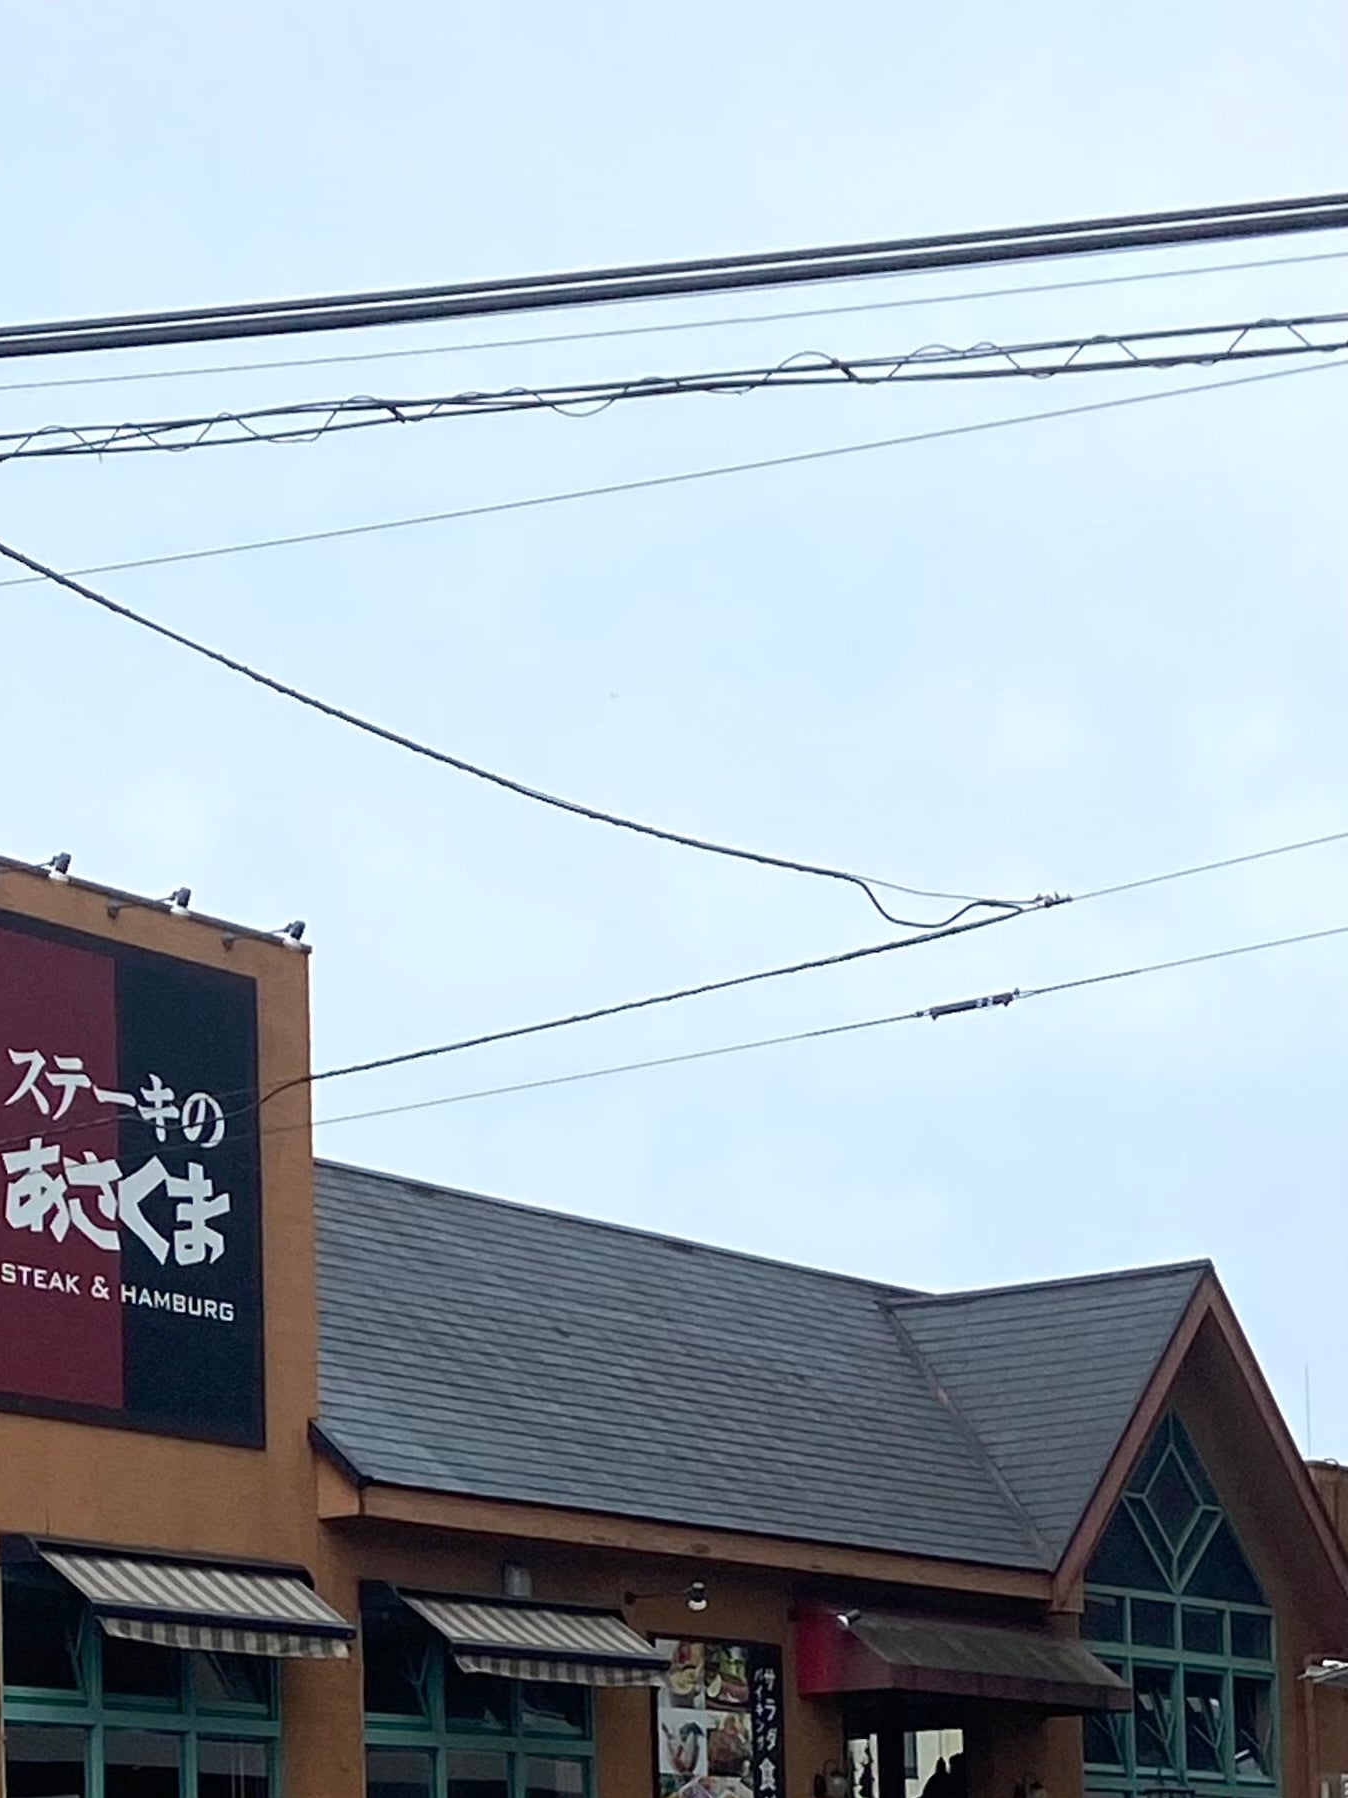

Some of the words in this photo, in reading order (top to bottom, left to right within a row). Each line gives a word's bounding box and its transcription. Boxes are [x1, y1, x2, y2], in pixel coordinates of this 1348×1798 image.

[5, 1048, 225, 1149] ステーキの
[1, 1137, 231, 1266] あさくま
[1, 1262, 81, 1296] STEAK
[90, 1275, 111, 1301] &
[120, 1283, 236, 1322] HAMBURG
